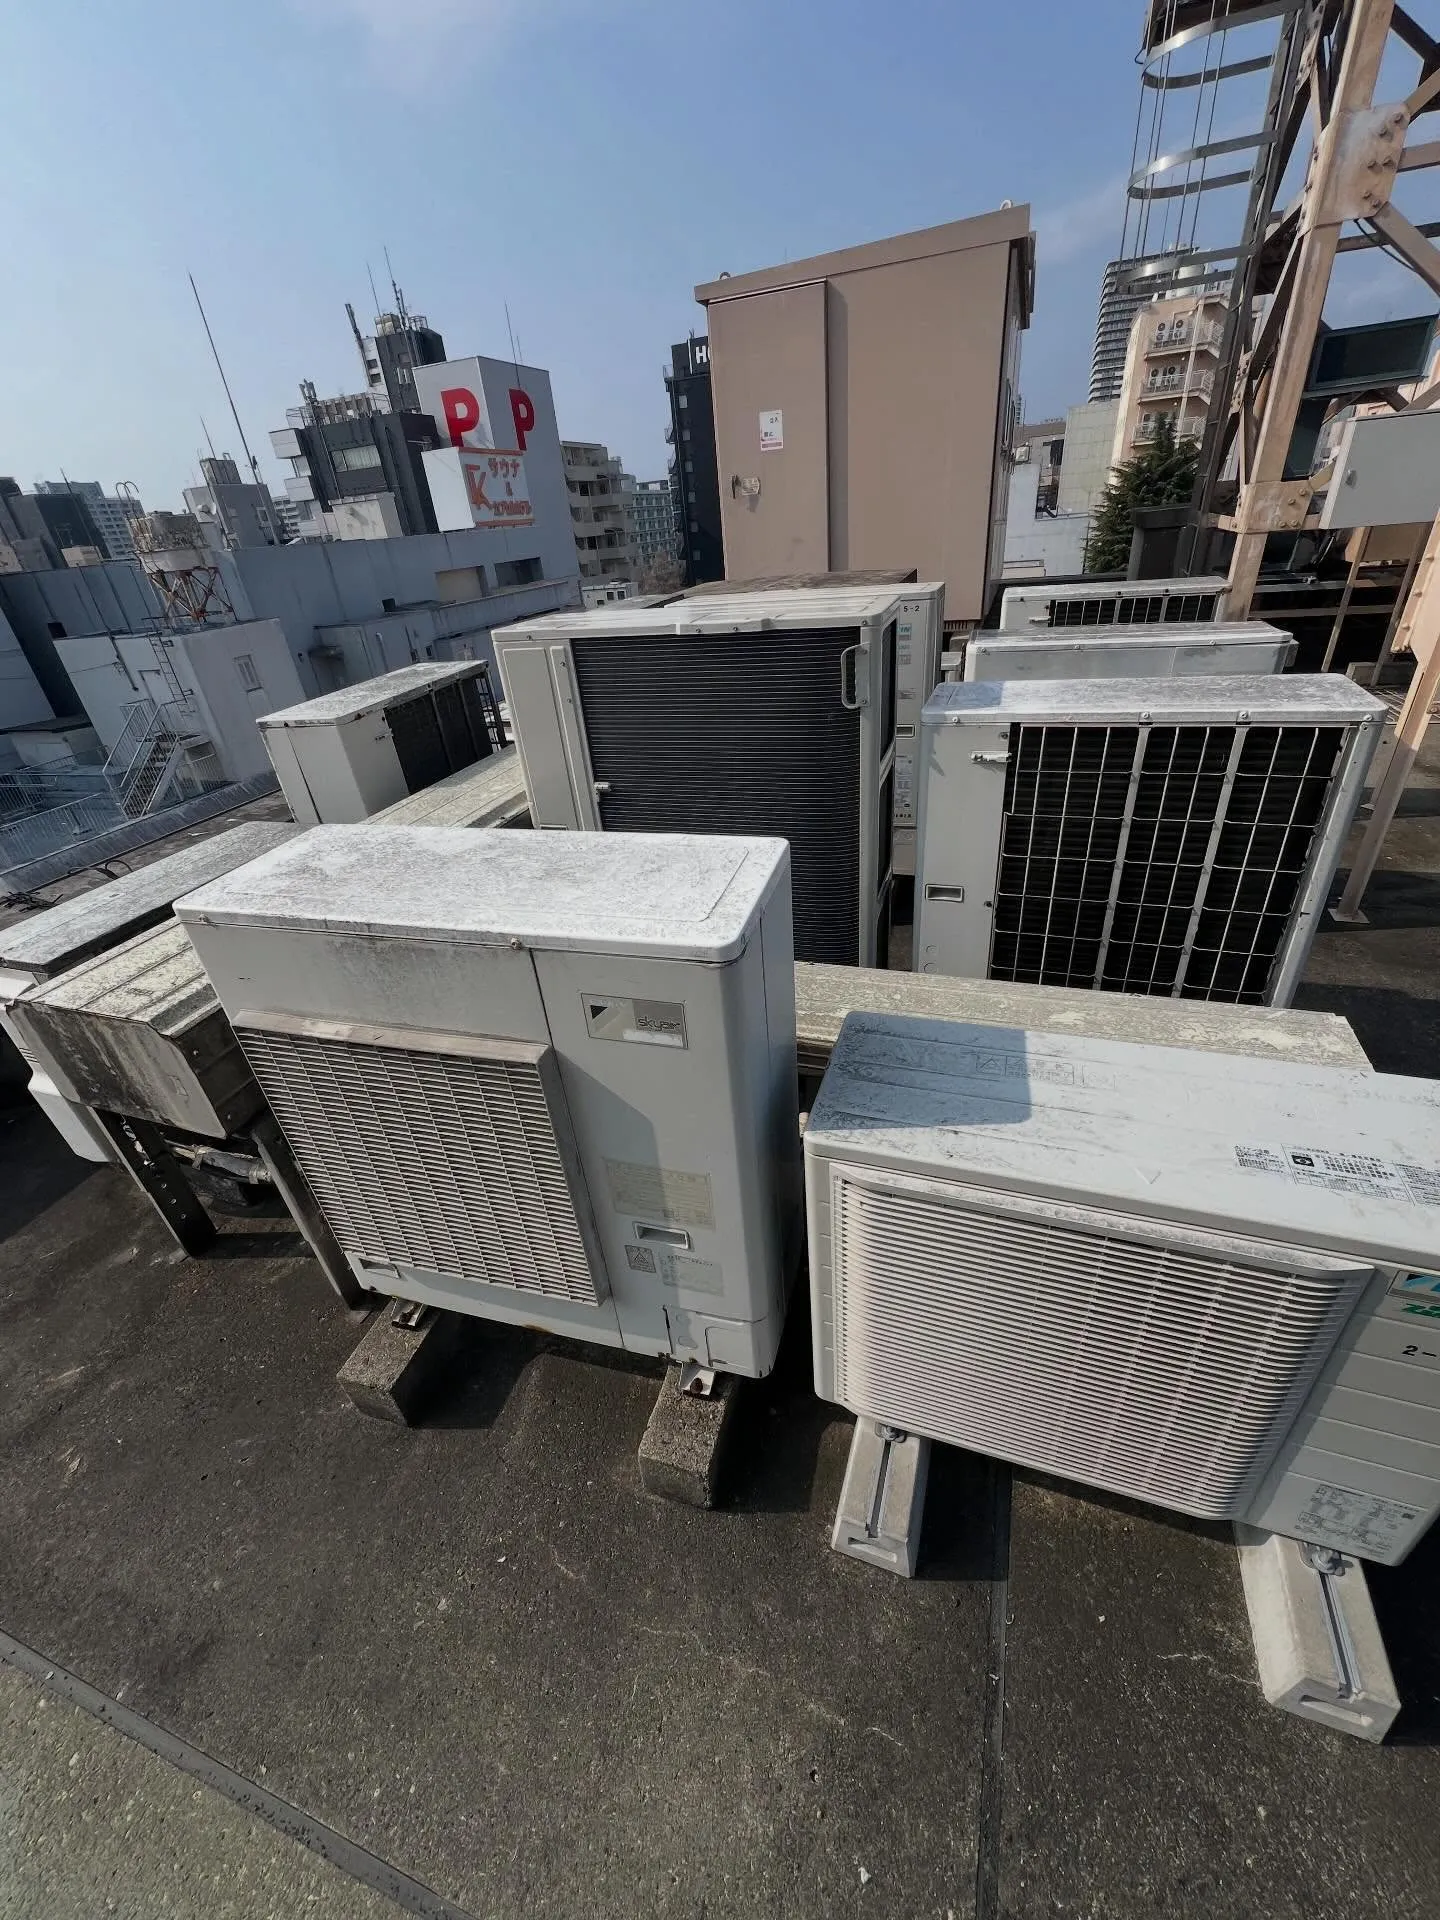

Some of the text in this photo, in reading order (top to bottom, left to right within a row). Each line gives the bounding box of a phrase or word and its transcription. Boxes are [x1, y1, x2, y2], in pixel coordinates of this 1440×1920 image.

[440, 387, 480, 447] P
[508, 388, 535, 450] P
[488, 458, 520, 478] サウナ
[903, 605, 920, 613] 5-2
